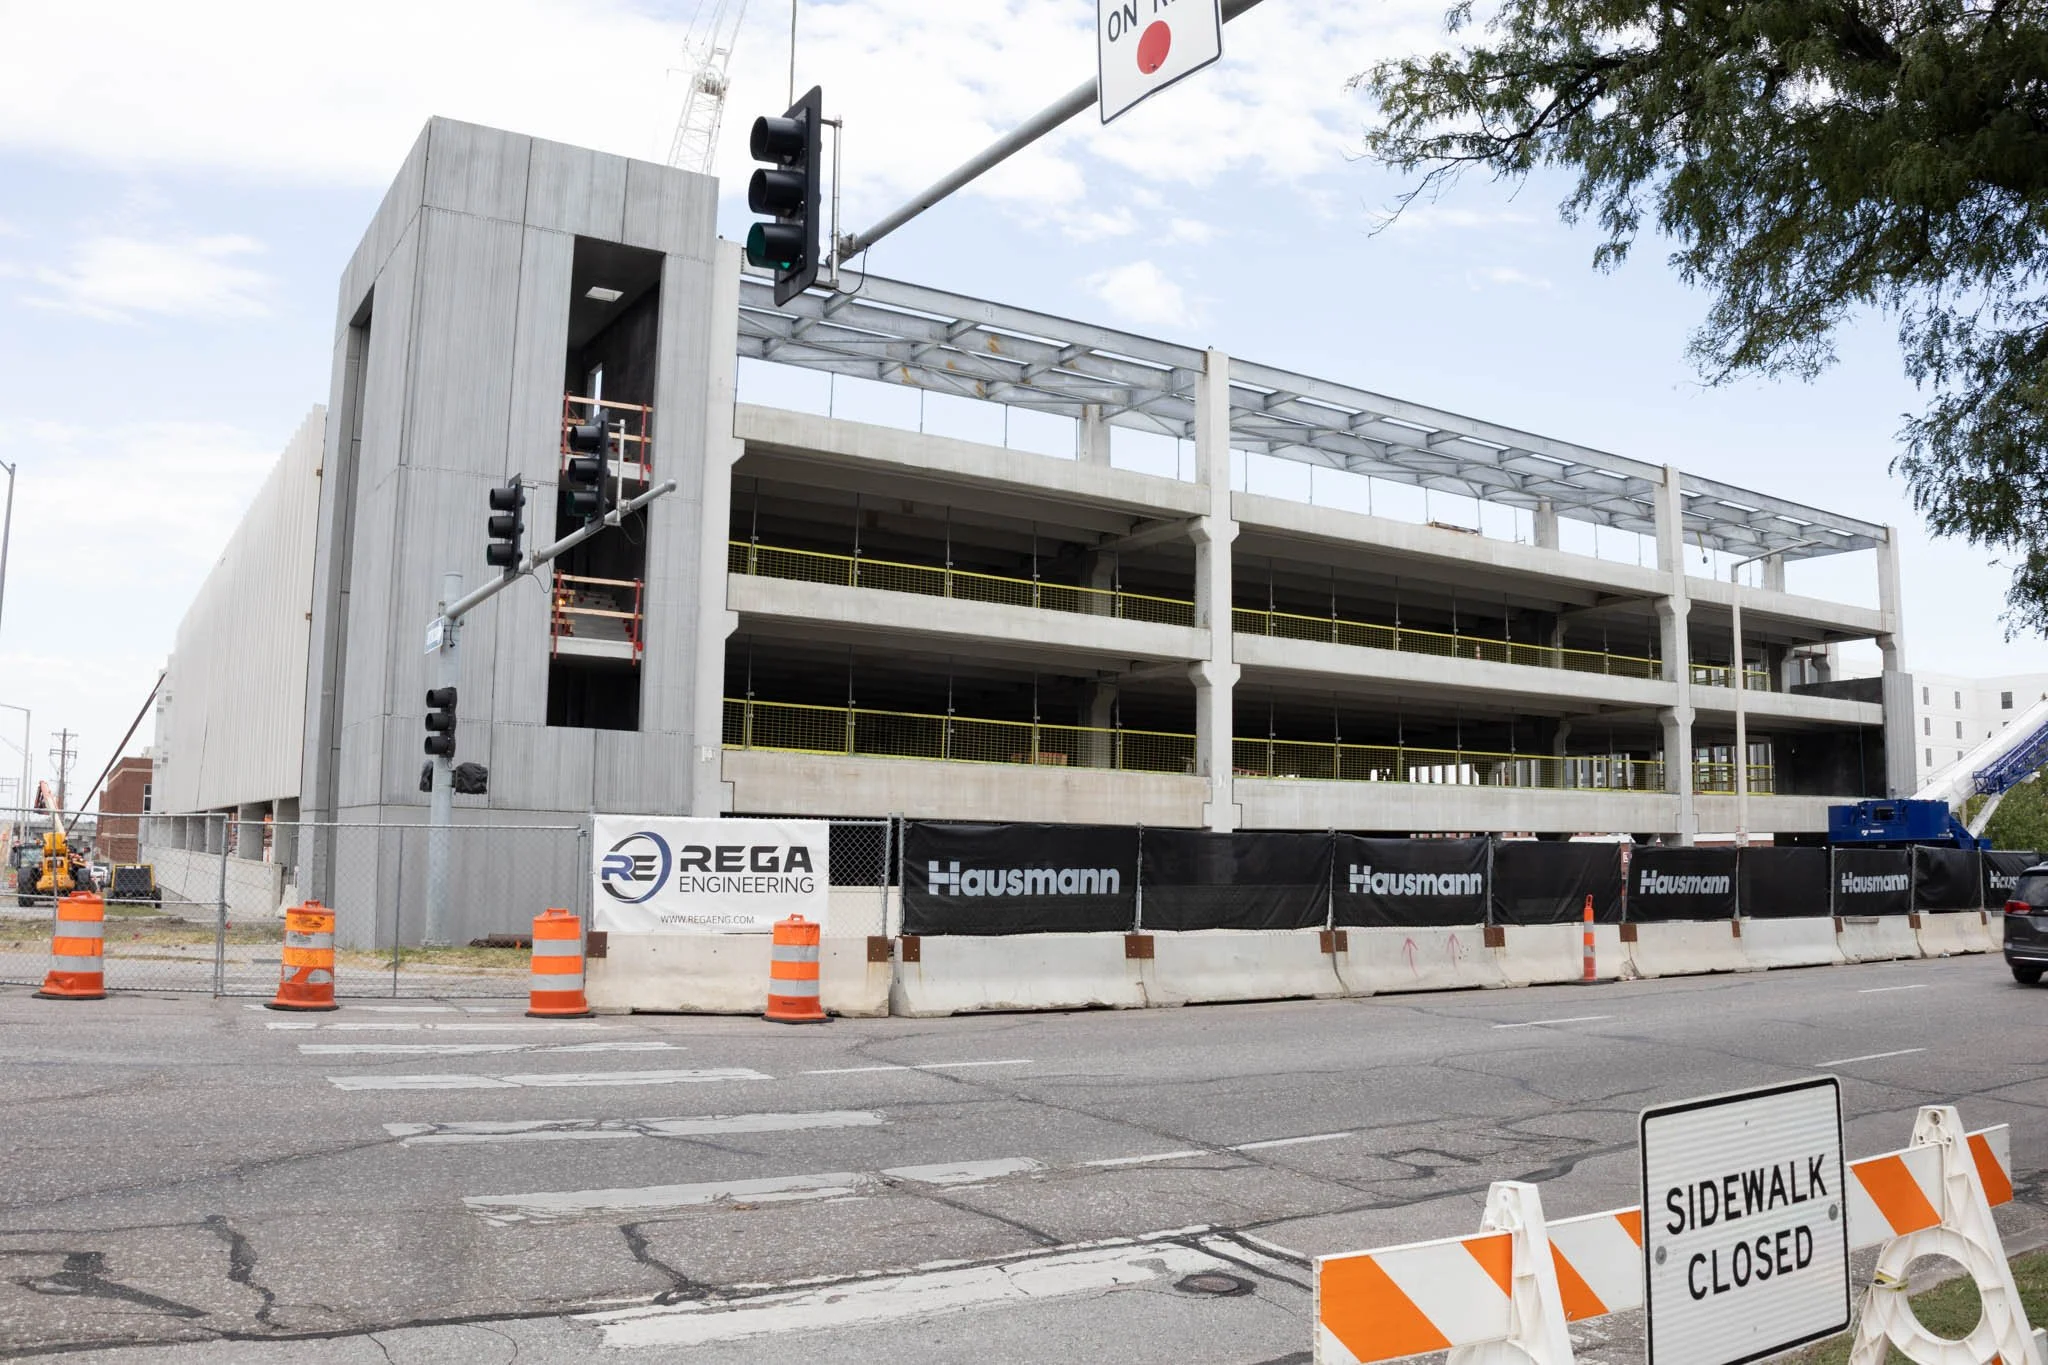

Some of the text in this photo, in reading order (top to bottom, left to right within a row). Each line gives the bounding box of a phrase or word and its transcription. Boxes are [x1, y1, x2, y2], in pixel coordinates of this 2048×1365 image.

[1108, 0, 1137, 42] ON
[680, 845, 814, 873] REGA
[679, 876, 815, 894] ENGINEERING
[928, 860, 1120, 897] Hausmann
[1349, 863, 1482, 896] Hausmann
[1639, 869, 1730, 895] Hausmann
[1841, 872, 1909, 894] Hausmann
[1990, 869, 2020, 890] Haus
[660, 914, 755, 925] WWW.REGAENG.COM
[1666, 1153, 1828, 1236] SIDEWALK
[1688, 1224, 1813, 1301] CLOSED
